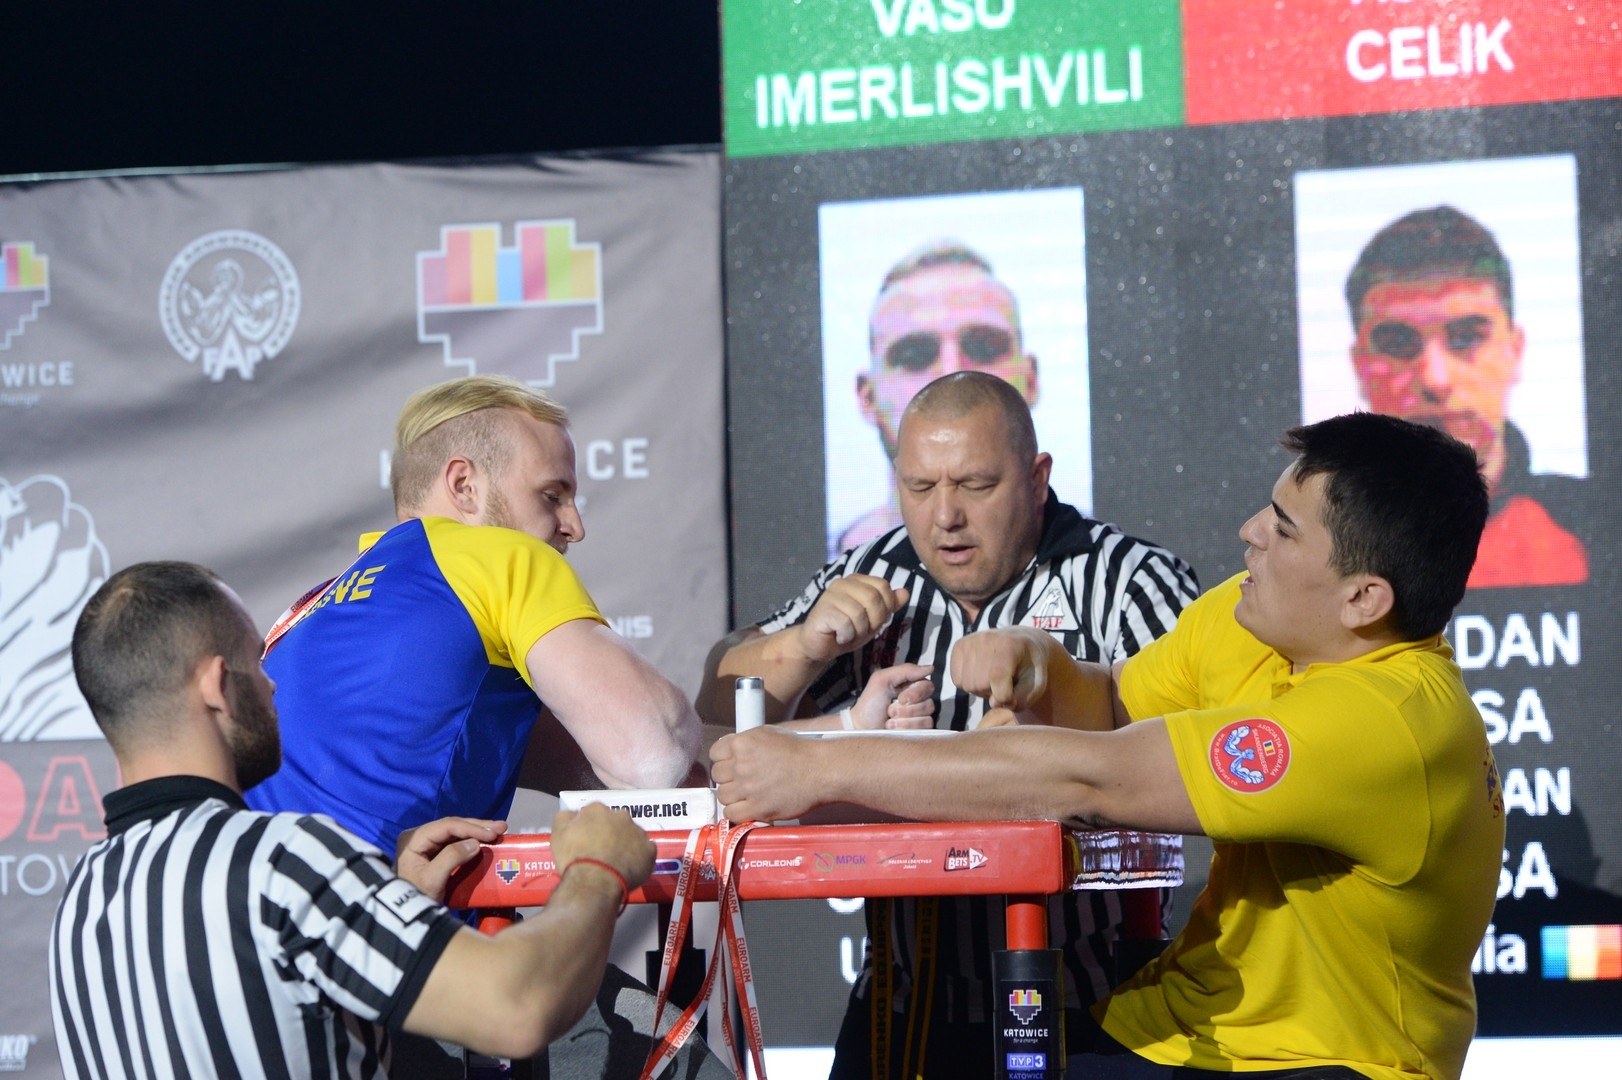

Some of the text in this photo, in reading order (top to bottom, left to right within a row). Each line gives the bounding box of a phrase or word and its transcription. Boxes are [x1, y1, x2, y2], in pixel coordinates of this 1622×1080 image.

[868, 0, 1016, 37] VASO
[1345, 16, 1516, 83] CELIK
[755, 45, 1144, 128] IMERLISHVILI
[1453, 610, 1581, 670] DAN
[677, 852, 693, 897] EUROARM
[836, 855, 866, 866] MPGK
[948, 858, 968, 870] BETS
[663, 921, 679, 966] EUROARM
[736, 937, 752, 983] EUROARM
[665, 1020, 696, 1059] EUROARM
[749, 1006, 764, 1053] EUROARM
[1003, 1028, 1048, 1037] KATOWICE
